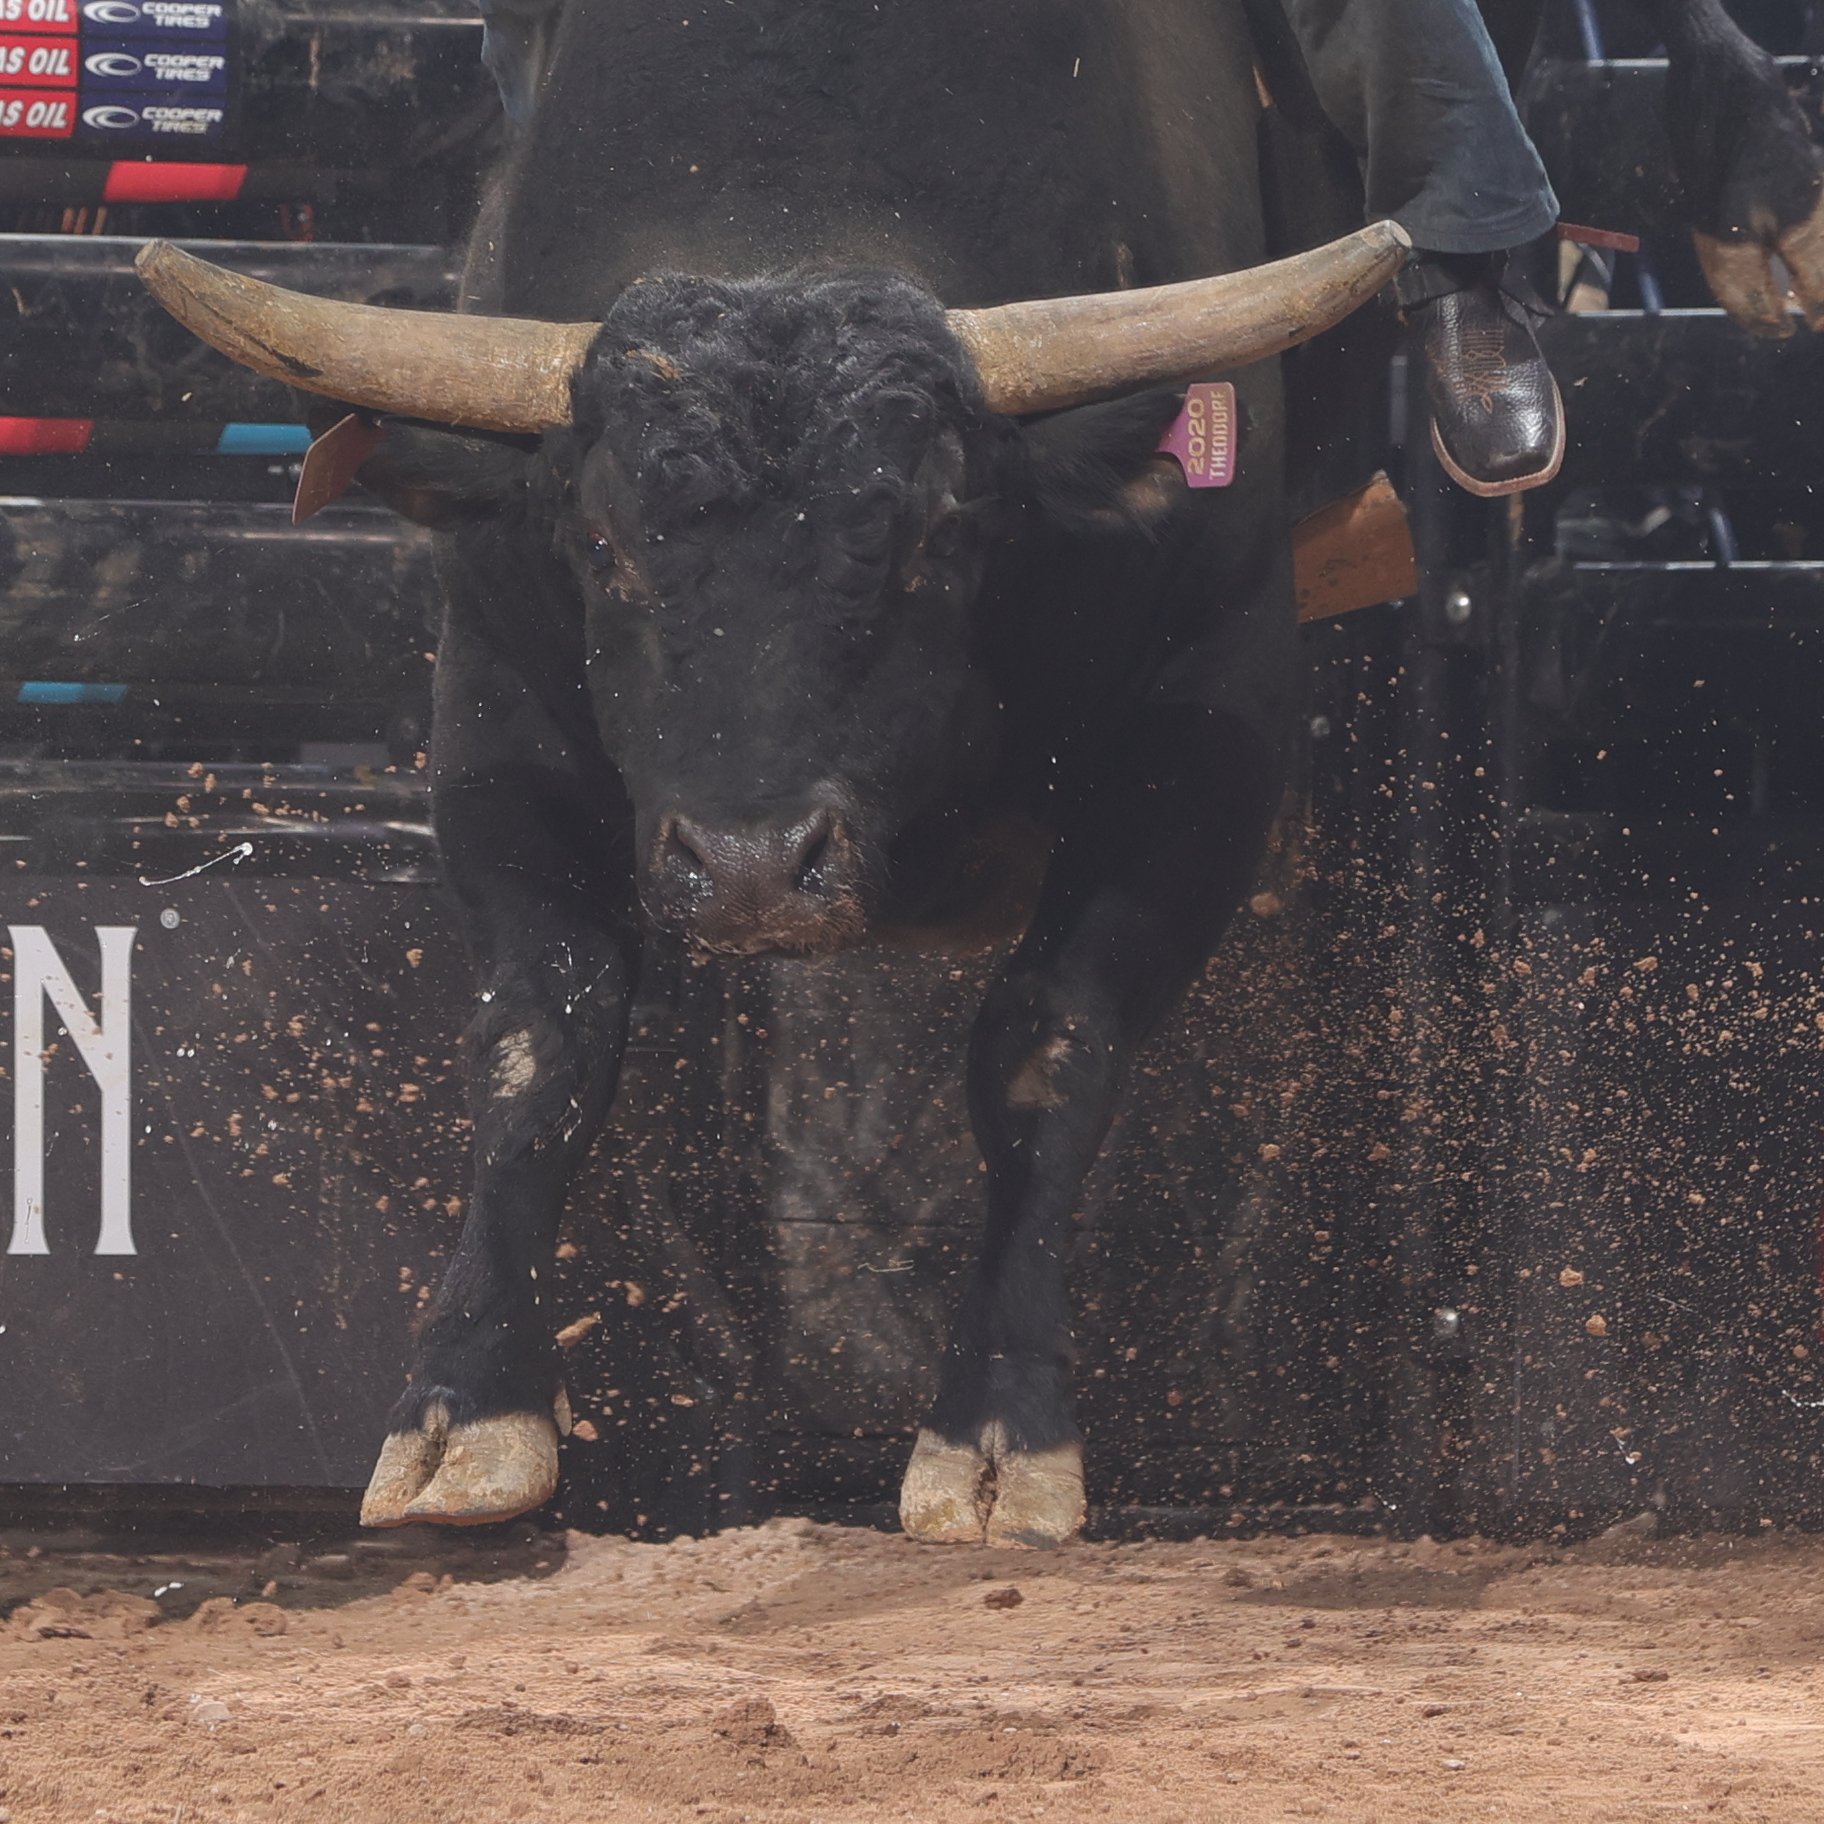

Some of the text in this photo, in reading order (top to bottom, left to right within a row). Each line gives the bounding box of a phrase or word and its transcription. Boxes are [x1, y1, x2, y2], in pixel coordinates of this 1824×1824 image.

[142, 1, 222, 17] COOPER
[153, 14, 211, 28] TIRES
[28, 47, 70, 75] OIL
[144, 54, 224, 69] COOPER
[154, 66, 211, 82] TIRES
[26, 101, 69, 129] OIL
[142, 107, 223, 122] COOPER
[152, 119, 208, 134] TIRES
[1187, 398, 1206, 475] 2020
[1209, 390, 1228, 480] THEODORE
